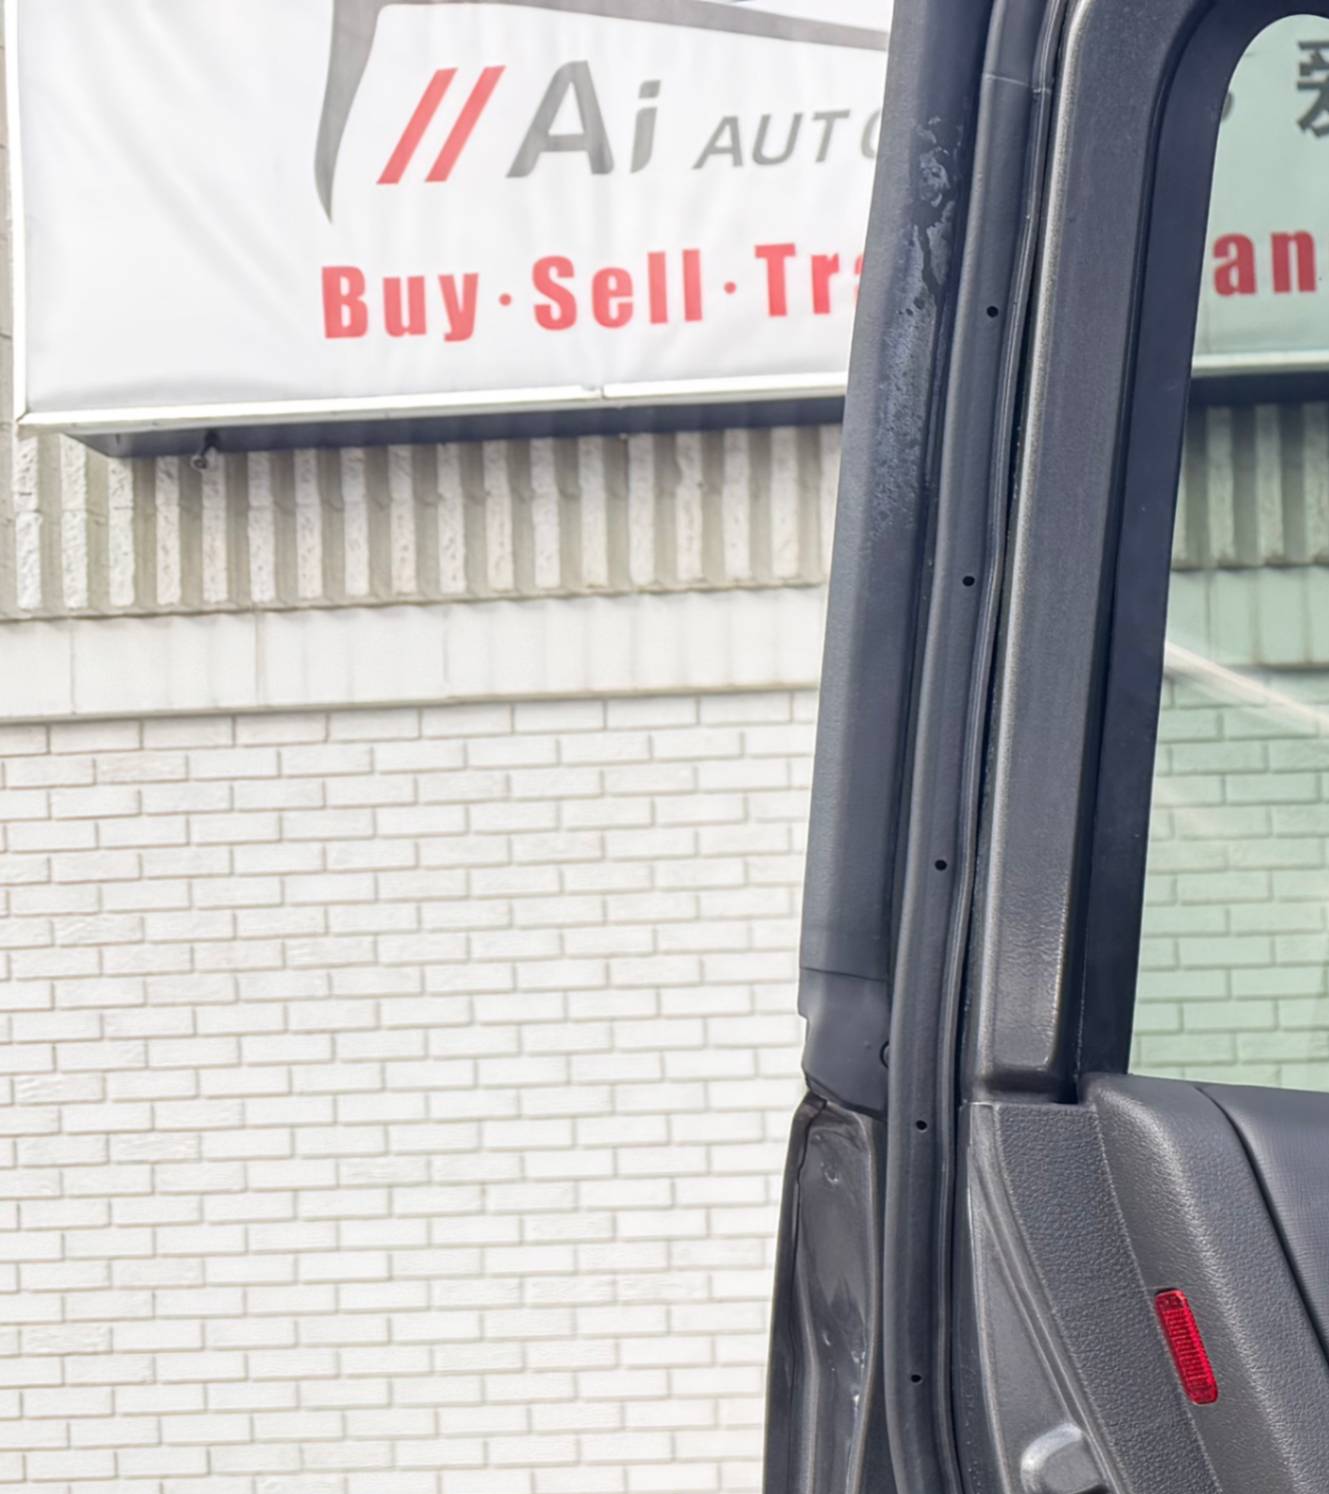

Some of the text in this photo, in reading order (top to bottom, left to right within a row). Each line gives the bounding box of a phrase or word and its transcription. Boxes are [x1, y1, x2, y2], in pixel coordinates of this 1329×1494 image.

[506, 60, 661, 178] Ai
[321, 242, 864, 342] Buy Sell Tr
